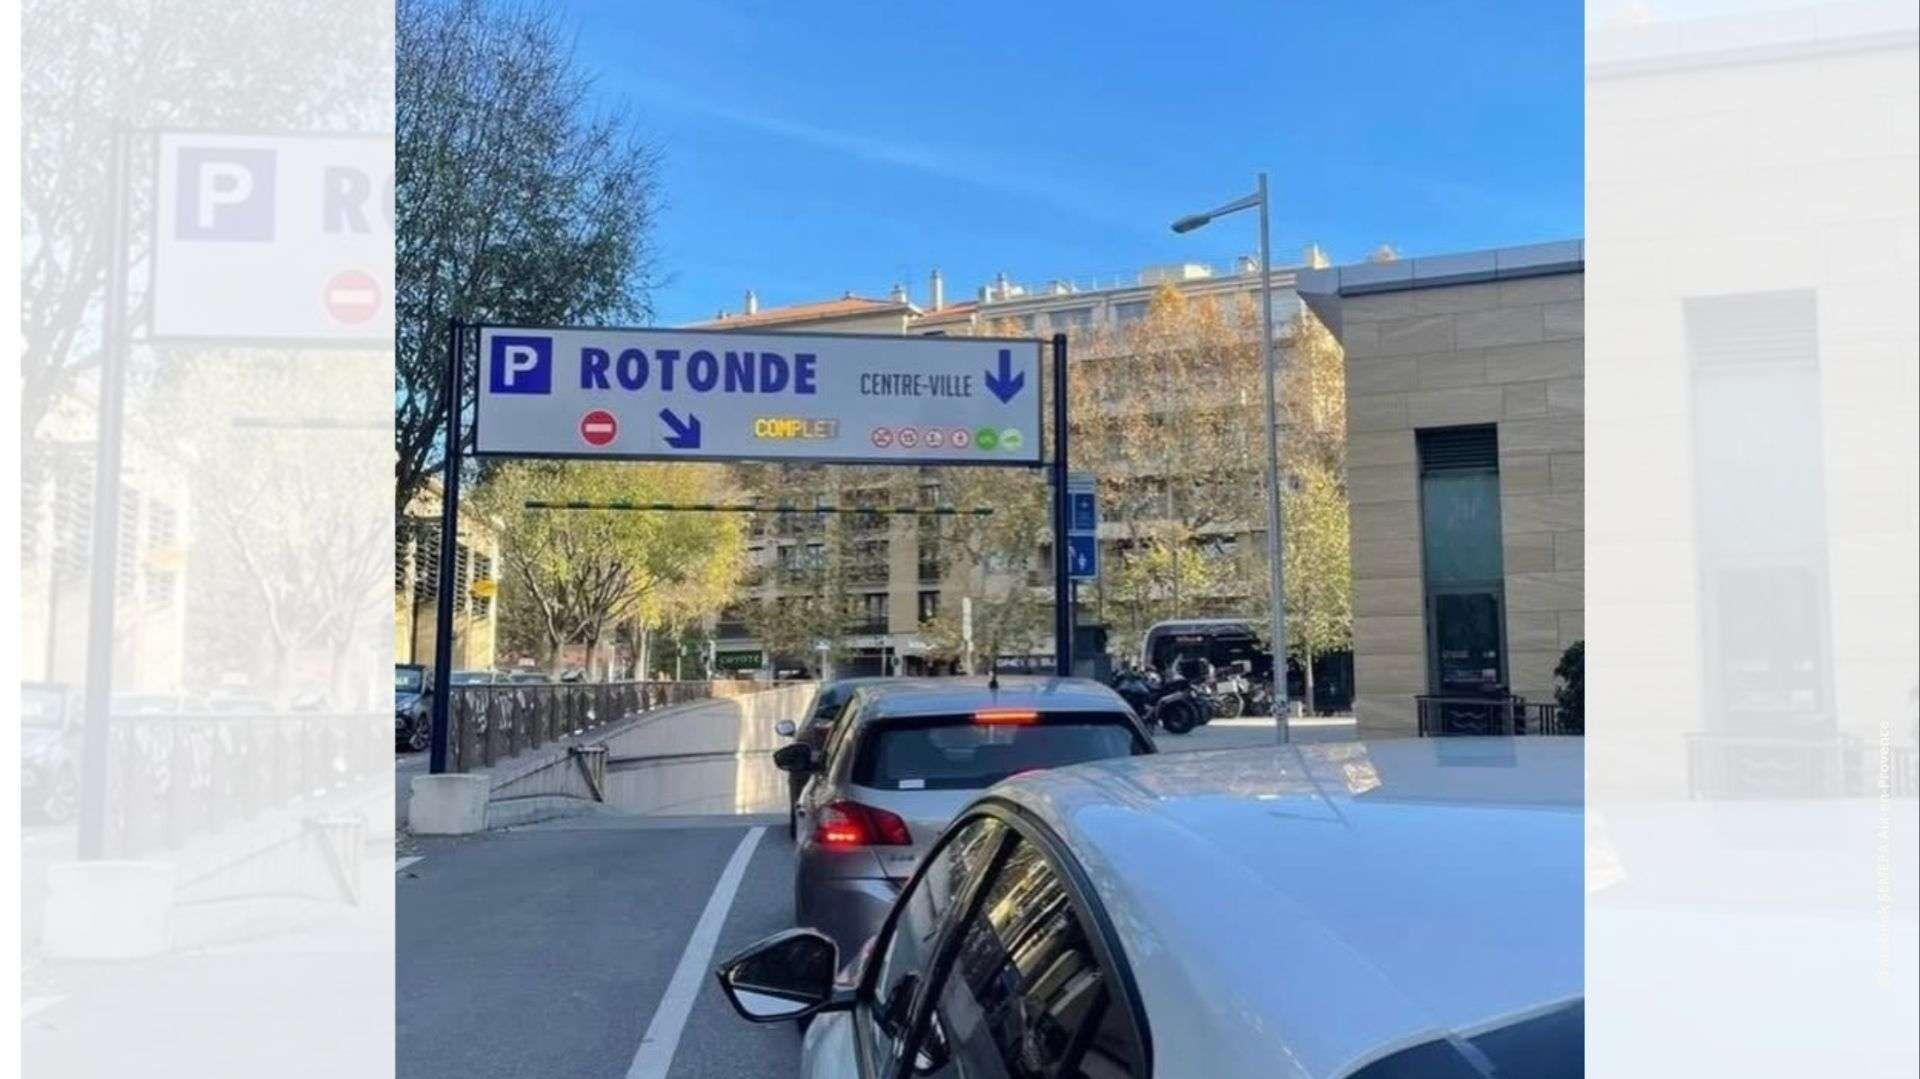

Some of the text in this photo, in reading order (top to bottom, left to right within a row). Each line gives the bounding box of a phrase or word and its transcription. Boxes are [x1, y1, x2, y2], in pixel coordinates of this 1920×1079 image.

[323, 166, 395, 234] R
[503, 344, 816, 394] P ROTONDE
[859, 372, 974, 399] CENTRE-VILLE
[754, 418, 839, 438] COMPLET
